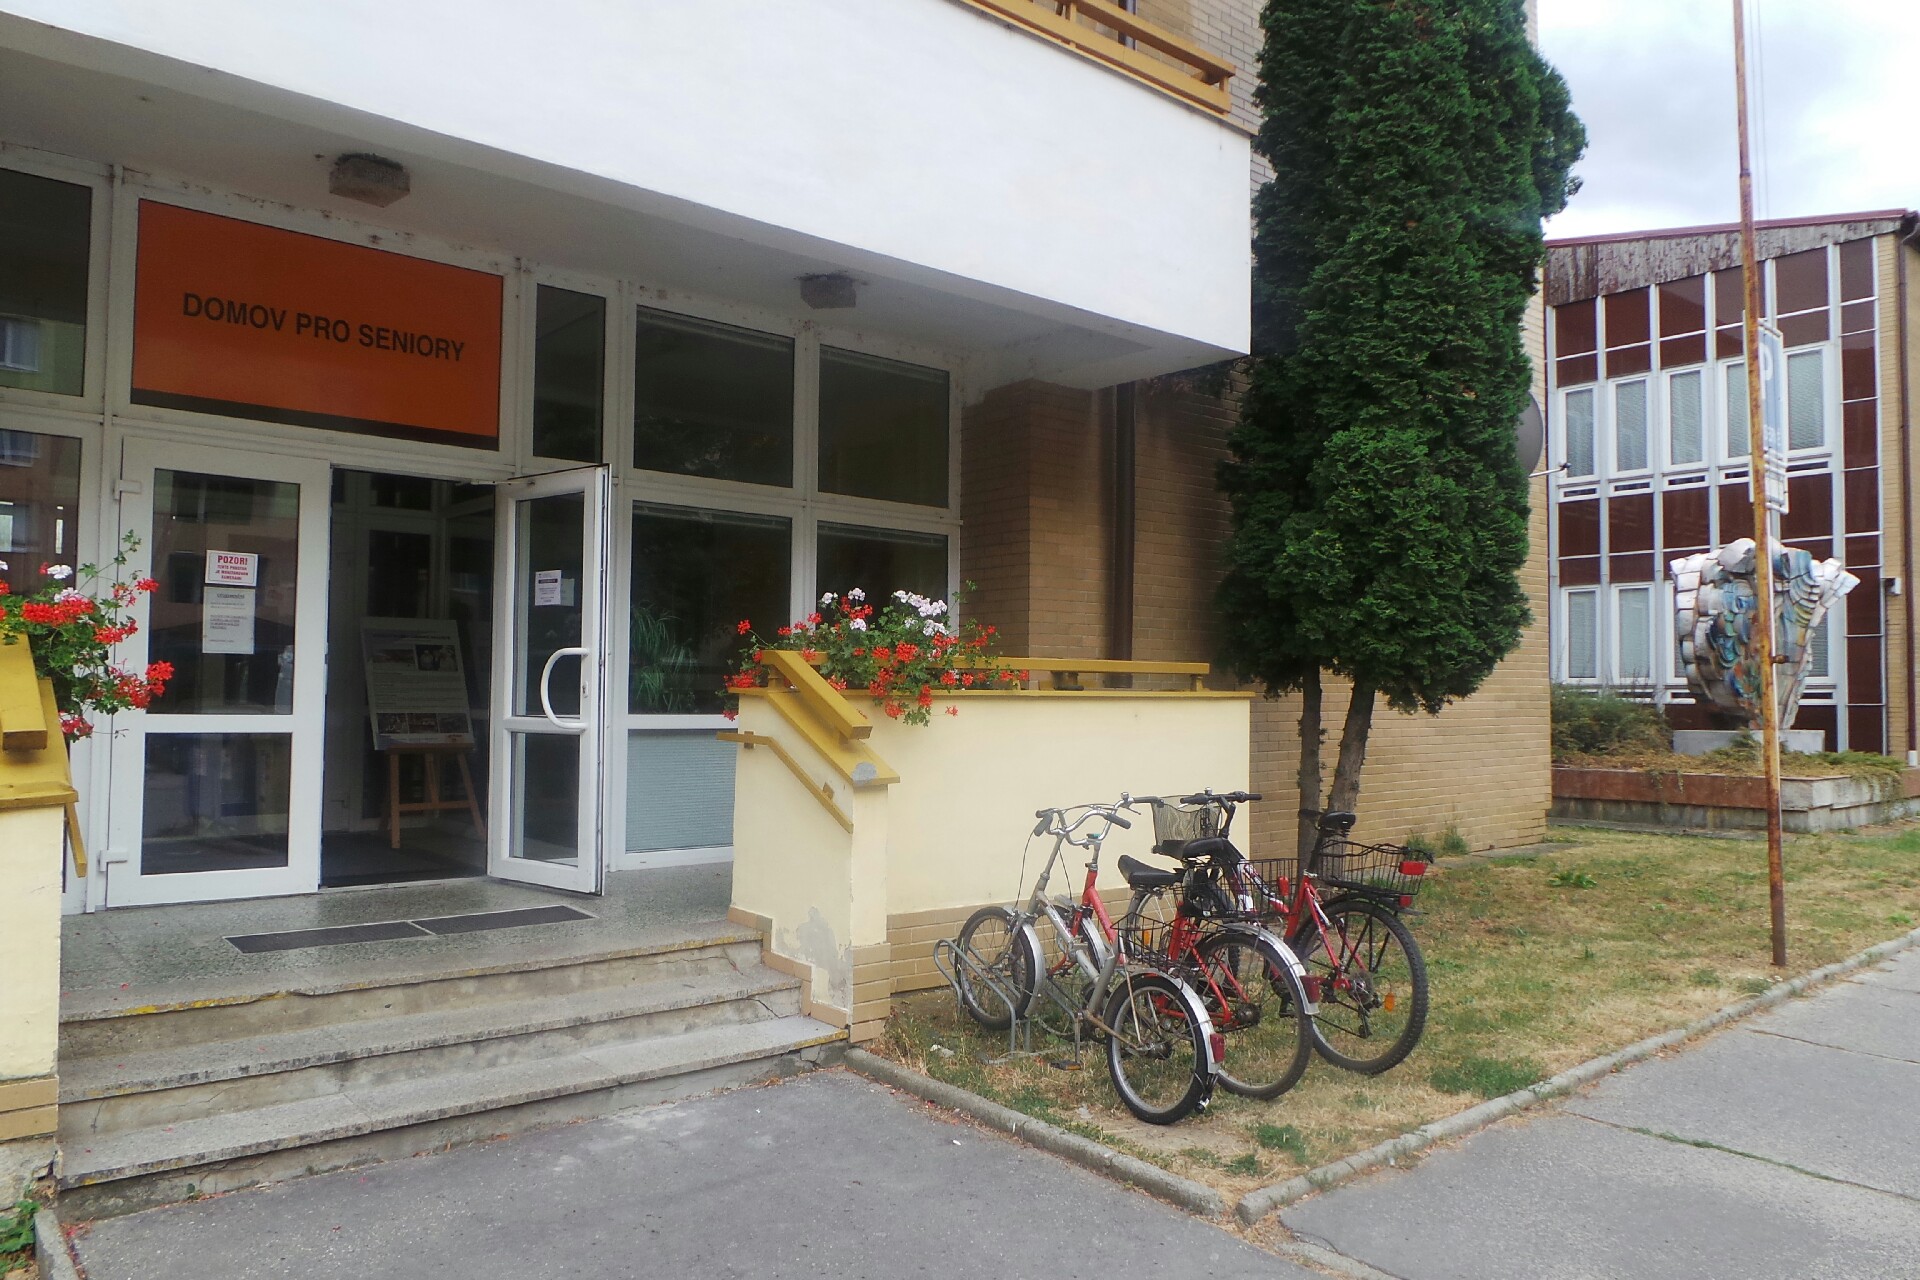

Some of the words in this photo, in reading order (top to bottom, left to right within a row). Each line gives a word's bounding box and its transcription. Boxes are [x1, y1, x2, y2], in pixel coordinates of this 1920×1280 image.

[182, 292, 287, 331] DOMOV
[296, 312, 350, 343] PRO
[358, 324, 465, 361] SENIORY
[217, 555, 248, 565] POZOR!
